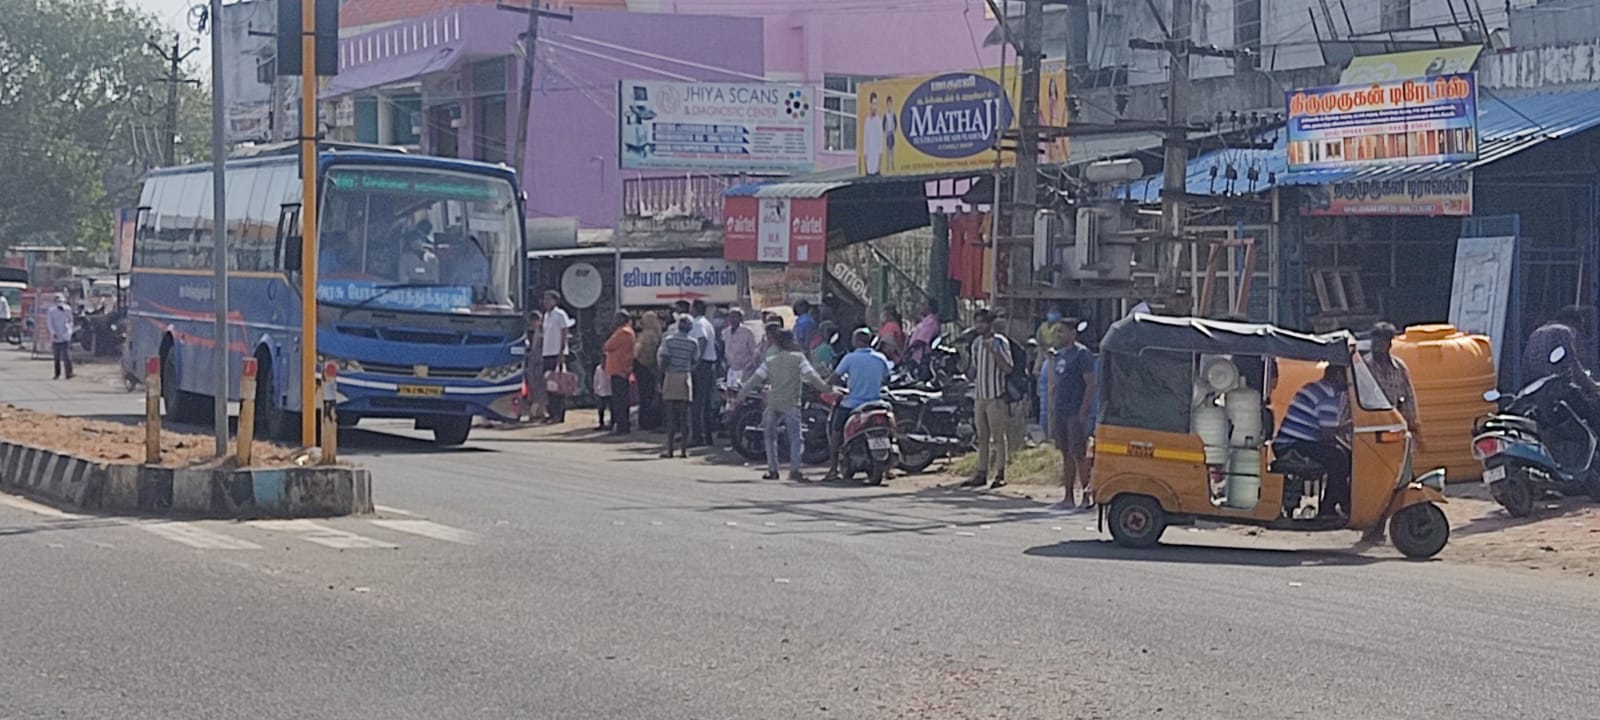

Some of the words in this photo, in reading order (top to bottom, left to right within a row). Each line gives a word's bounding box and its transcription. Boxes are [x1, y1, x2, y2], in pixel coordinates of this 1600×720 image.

[683, 87, 725, 103] JHIYA
[729, 88, 779, 105] SCANS
[1289, 84, 1385, 117] திருமுருகன்
[692, 106, 744, 117] DIAGNOSTIC
[734, 214, 756, 232] airtel
[800, 215, 823, 233] airtel
[623, 266, 662, 288] ஜியா
[665, 265, 737, 287] ஸ்கேன்ஸ்
